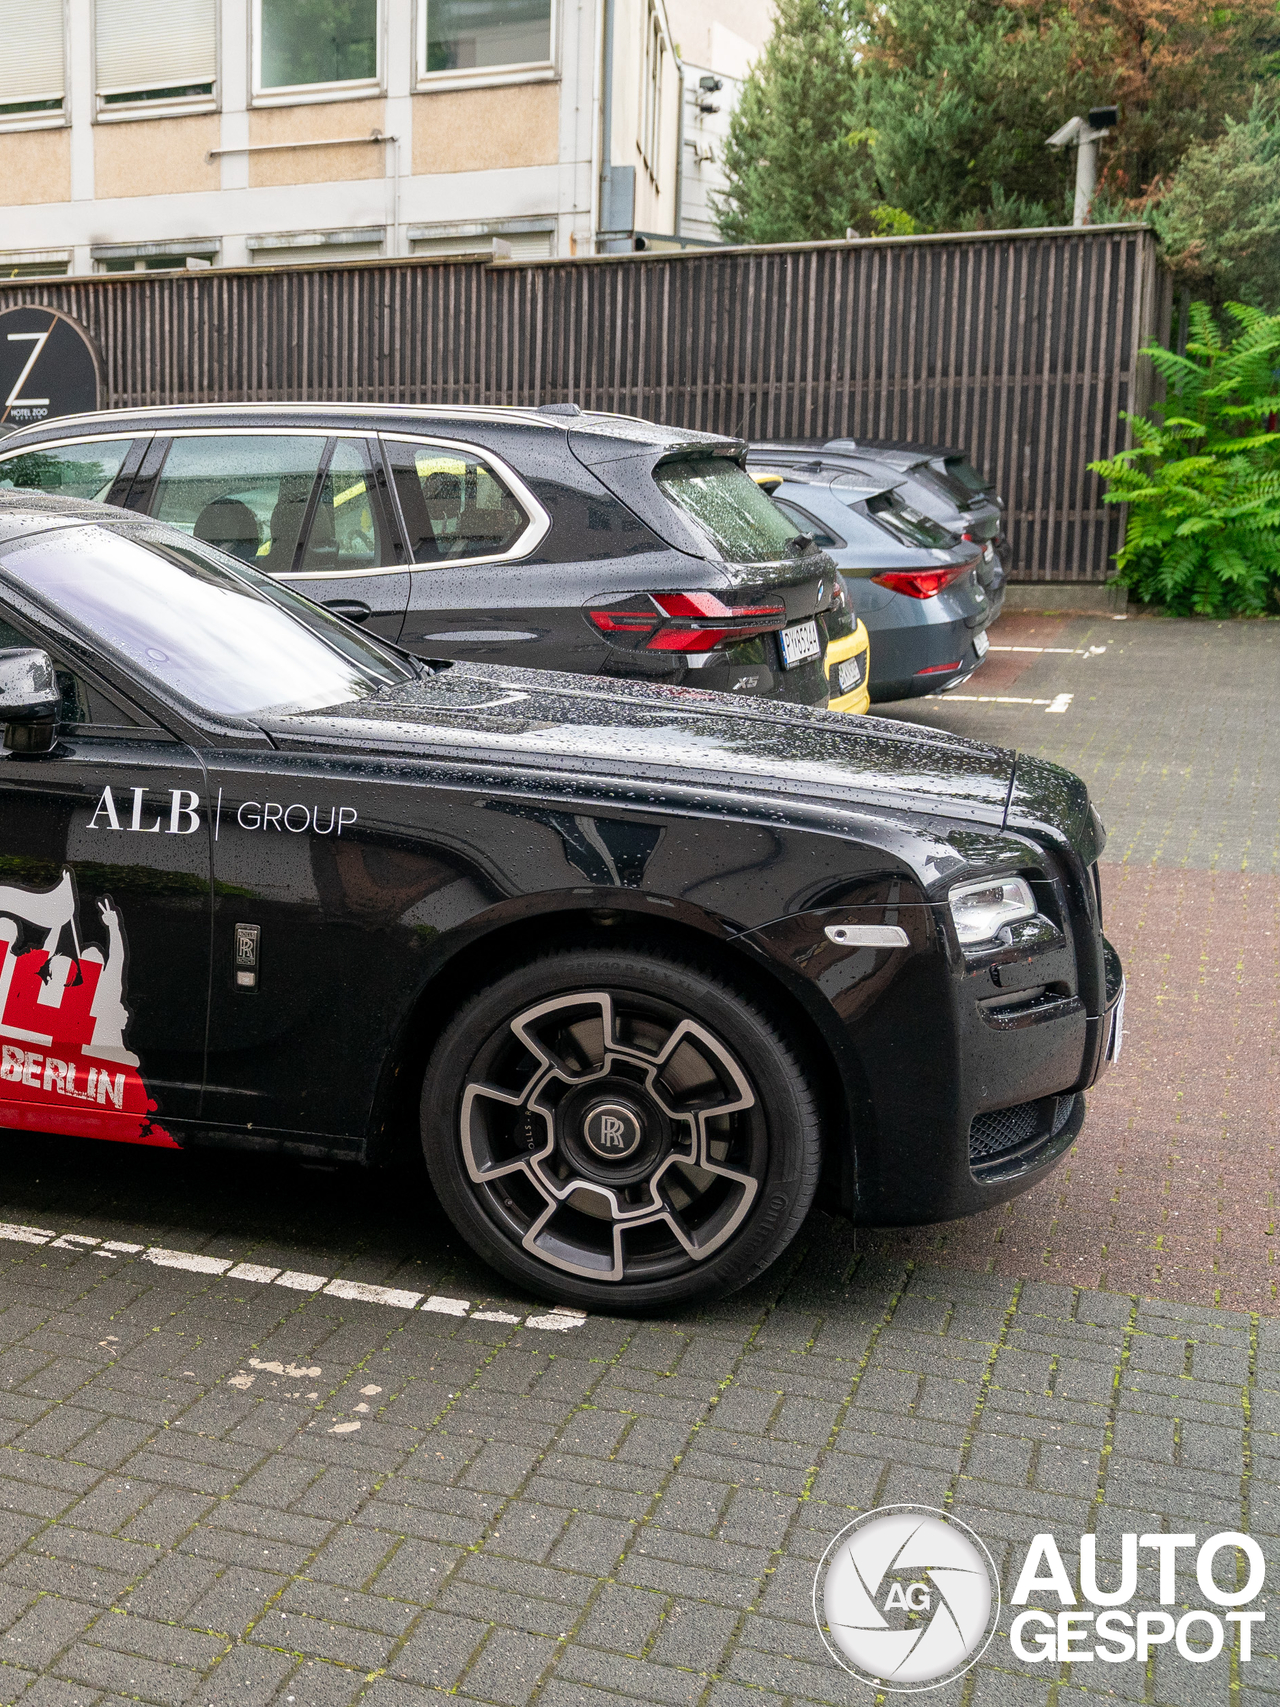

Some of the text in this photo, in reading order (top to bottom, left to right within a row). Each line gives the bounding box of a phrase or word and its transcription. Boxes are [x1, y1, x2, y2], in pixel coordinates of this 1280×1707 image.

[5, 332, 49, 406] Z
[10, 407, 48, 417] HOTEL ZOO
[784, 632, 797, 661] PY
[732, 675, 760, 690] X5
[86, 785, 358, 836] ALB GROUP
[0, 1044, 126, 1110] BERLIN
